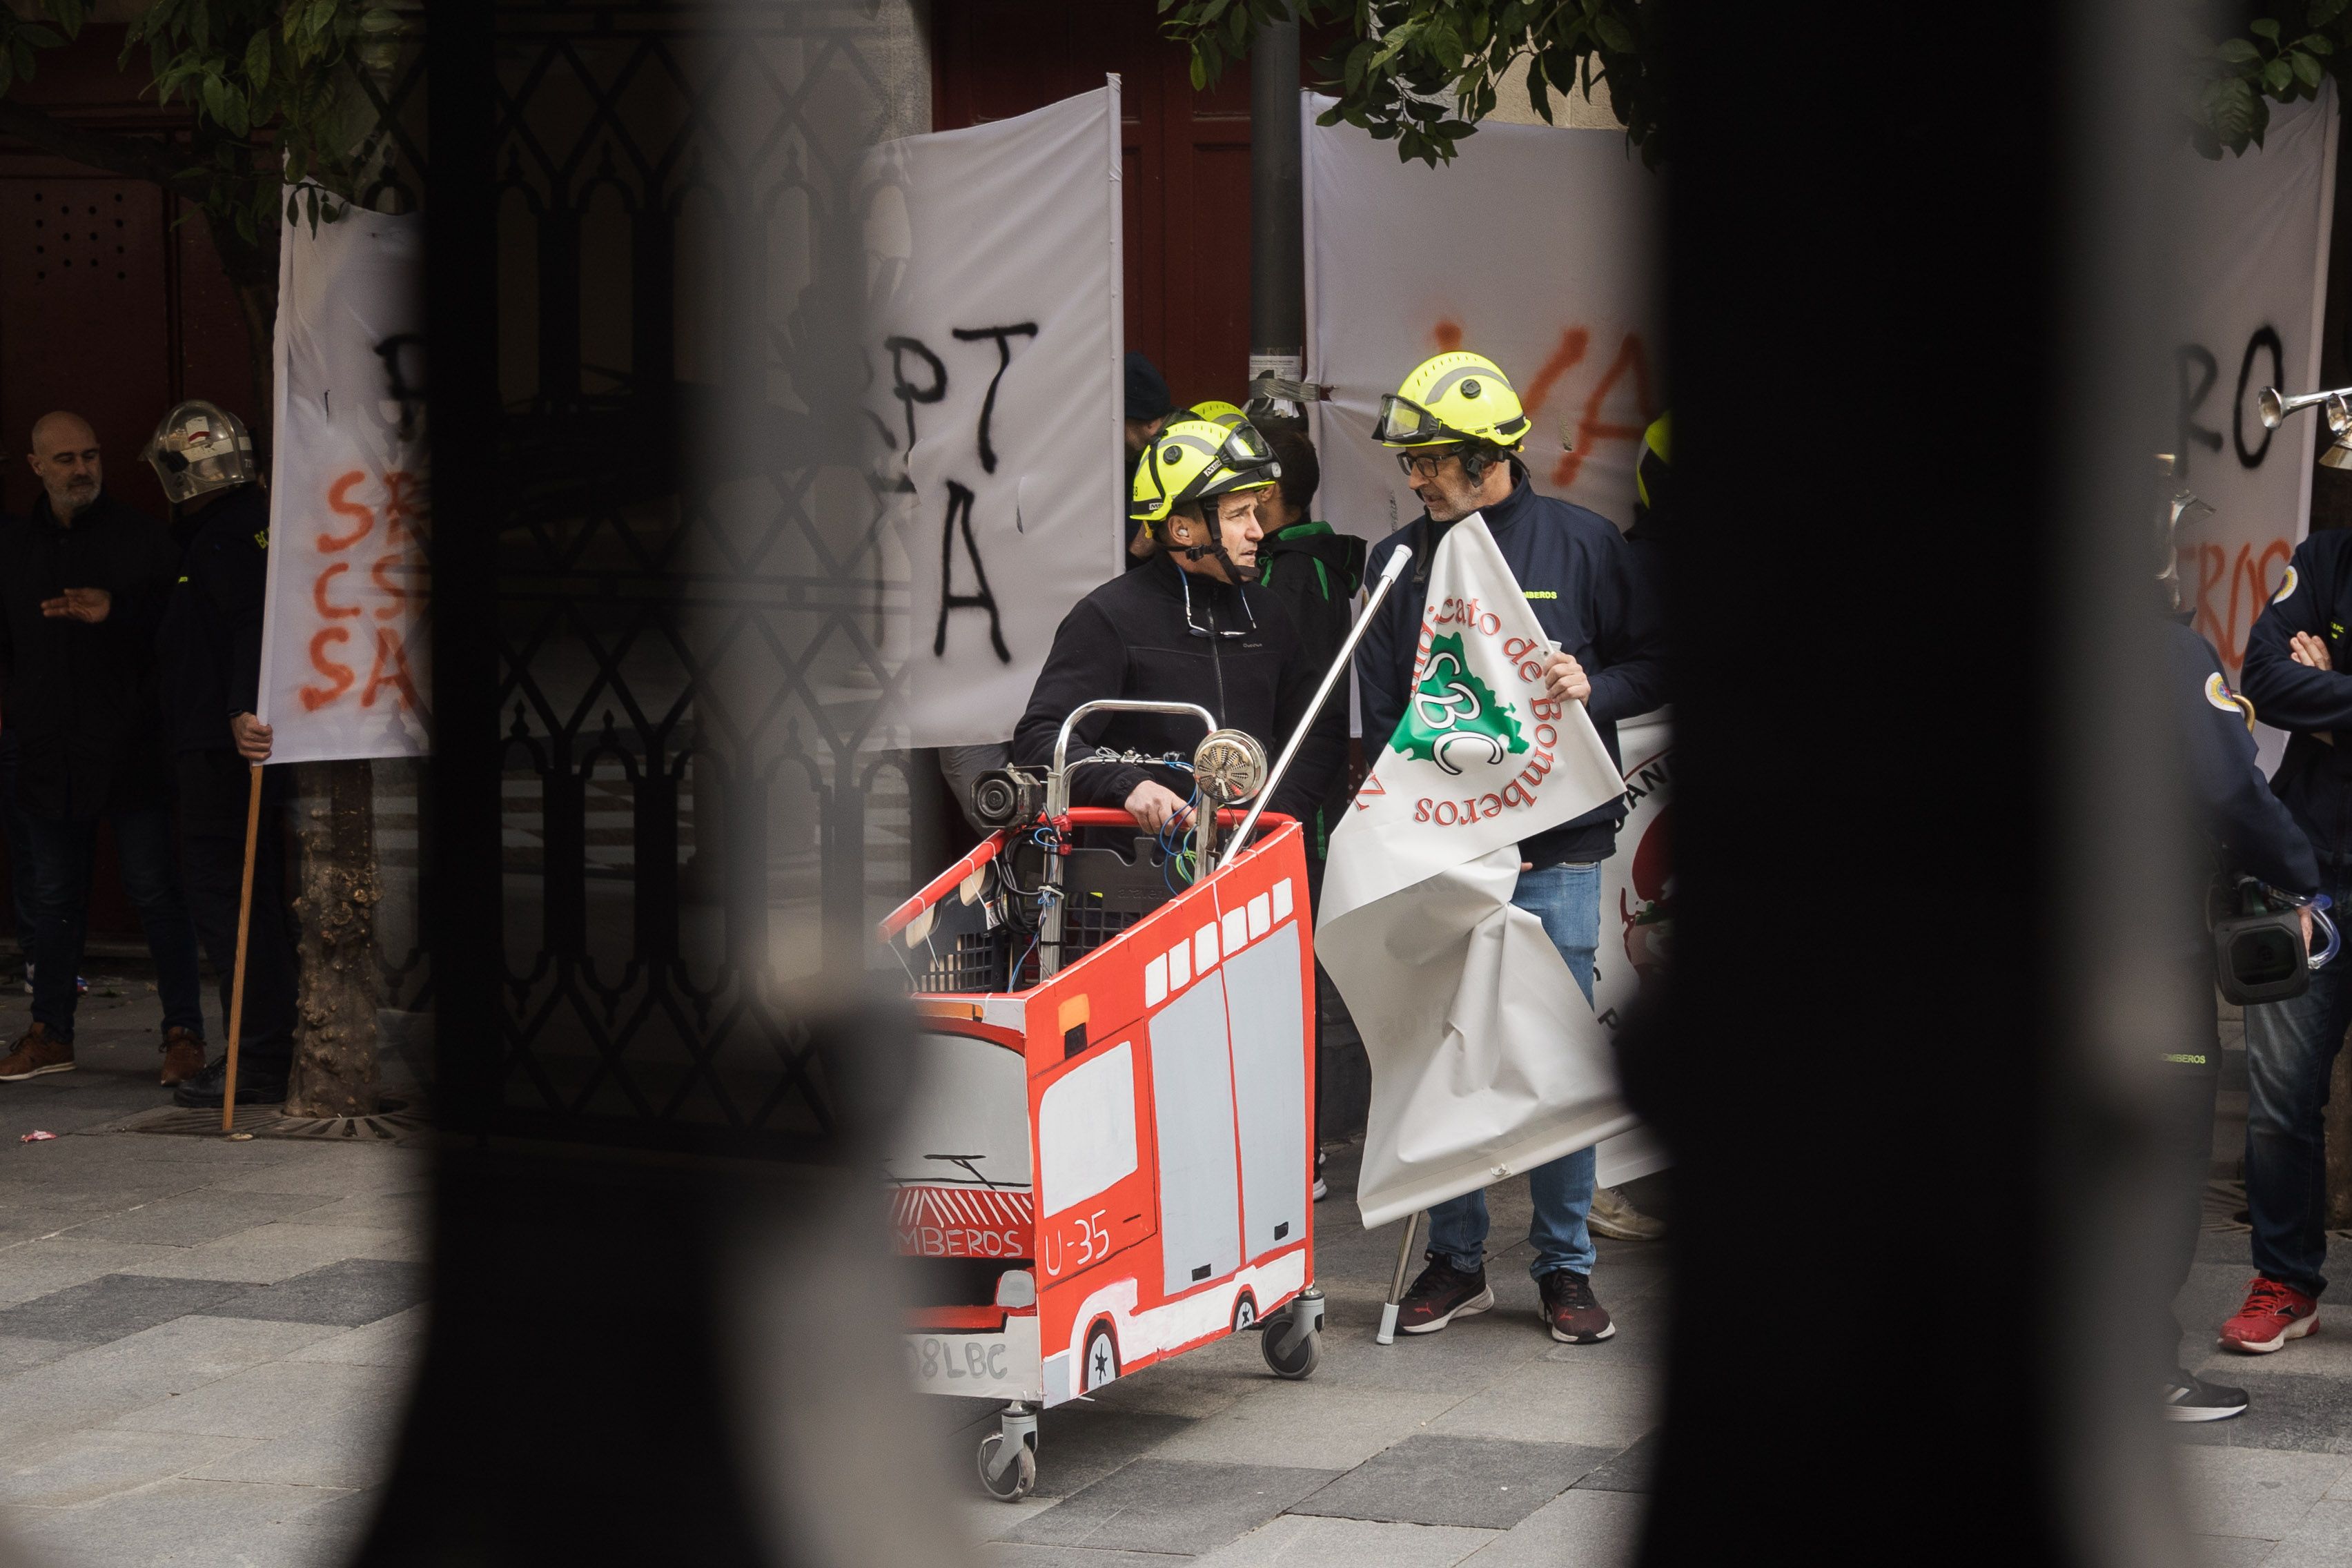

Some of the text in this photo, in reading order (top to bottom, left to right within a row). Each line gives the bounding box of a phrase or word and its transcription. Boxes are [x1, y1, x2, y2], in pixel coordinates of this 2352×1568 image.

[1523, 590, 1558, 599] MBEROS
[1503, 637, 1543, 683] de
[1415, 695, 1562, 826] Bomberos
[897, 1226, 1023, 1257] MBEROS
[1045, 1209, 1110, 1276] U-35
